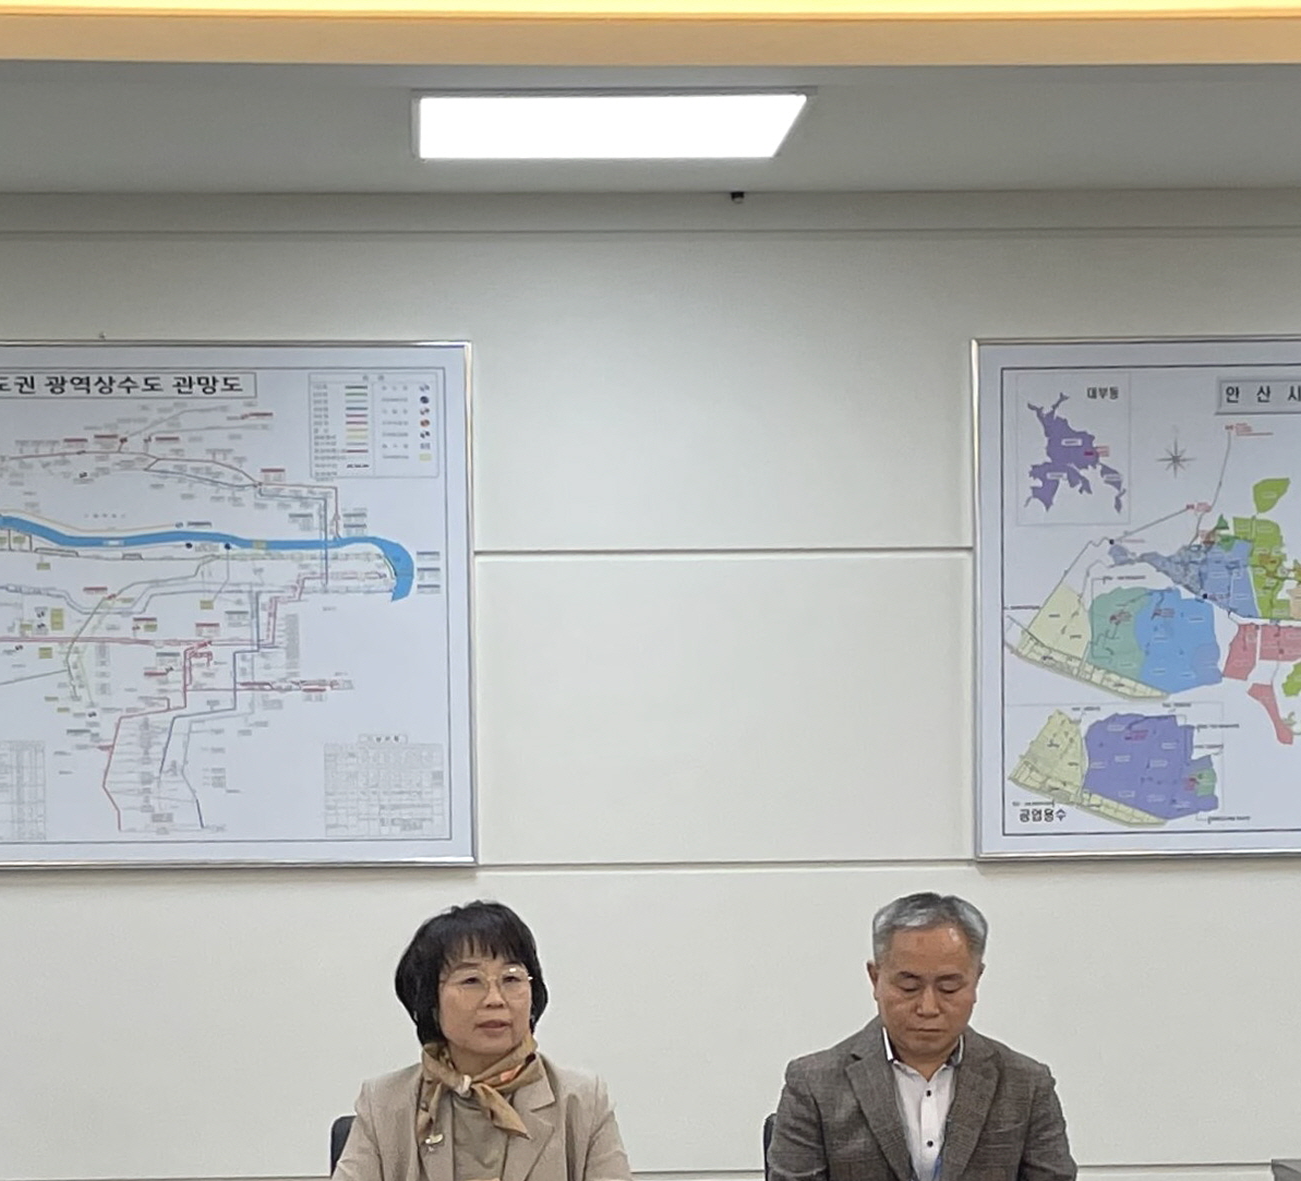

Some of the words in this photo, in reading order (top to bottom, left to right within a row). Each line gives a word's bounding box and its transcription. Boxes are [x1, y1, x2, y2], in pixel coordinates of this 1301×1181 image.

[44, 375, 164, 395] 광역상수도
[172, 375, 244, 395] 관망도
[1019, 808, 1067, 822] 공업용수
